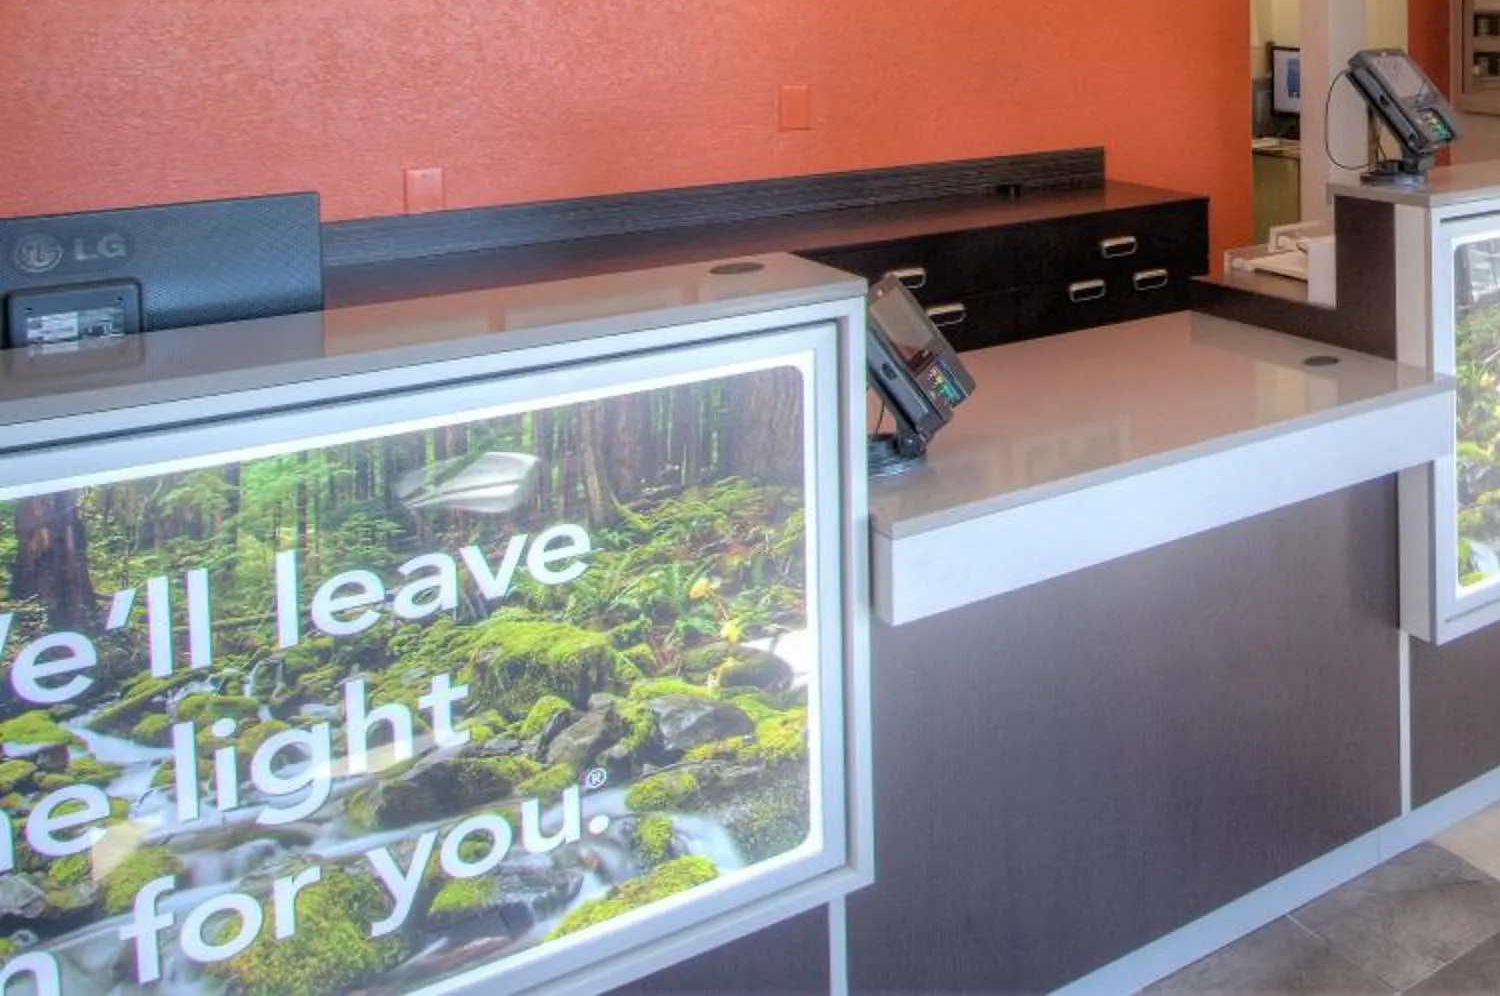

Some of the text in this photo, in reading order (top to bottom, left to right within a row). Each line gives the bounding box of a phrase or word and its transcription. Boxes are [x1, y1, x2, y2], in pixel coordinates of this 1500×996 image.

[74, 233, 127, 261] LG
[0, 520, 592, 704] e'll leave
[172, 672, 471, 827] light
[119, 859, 321, 985] for
